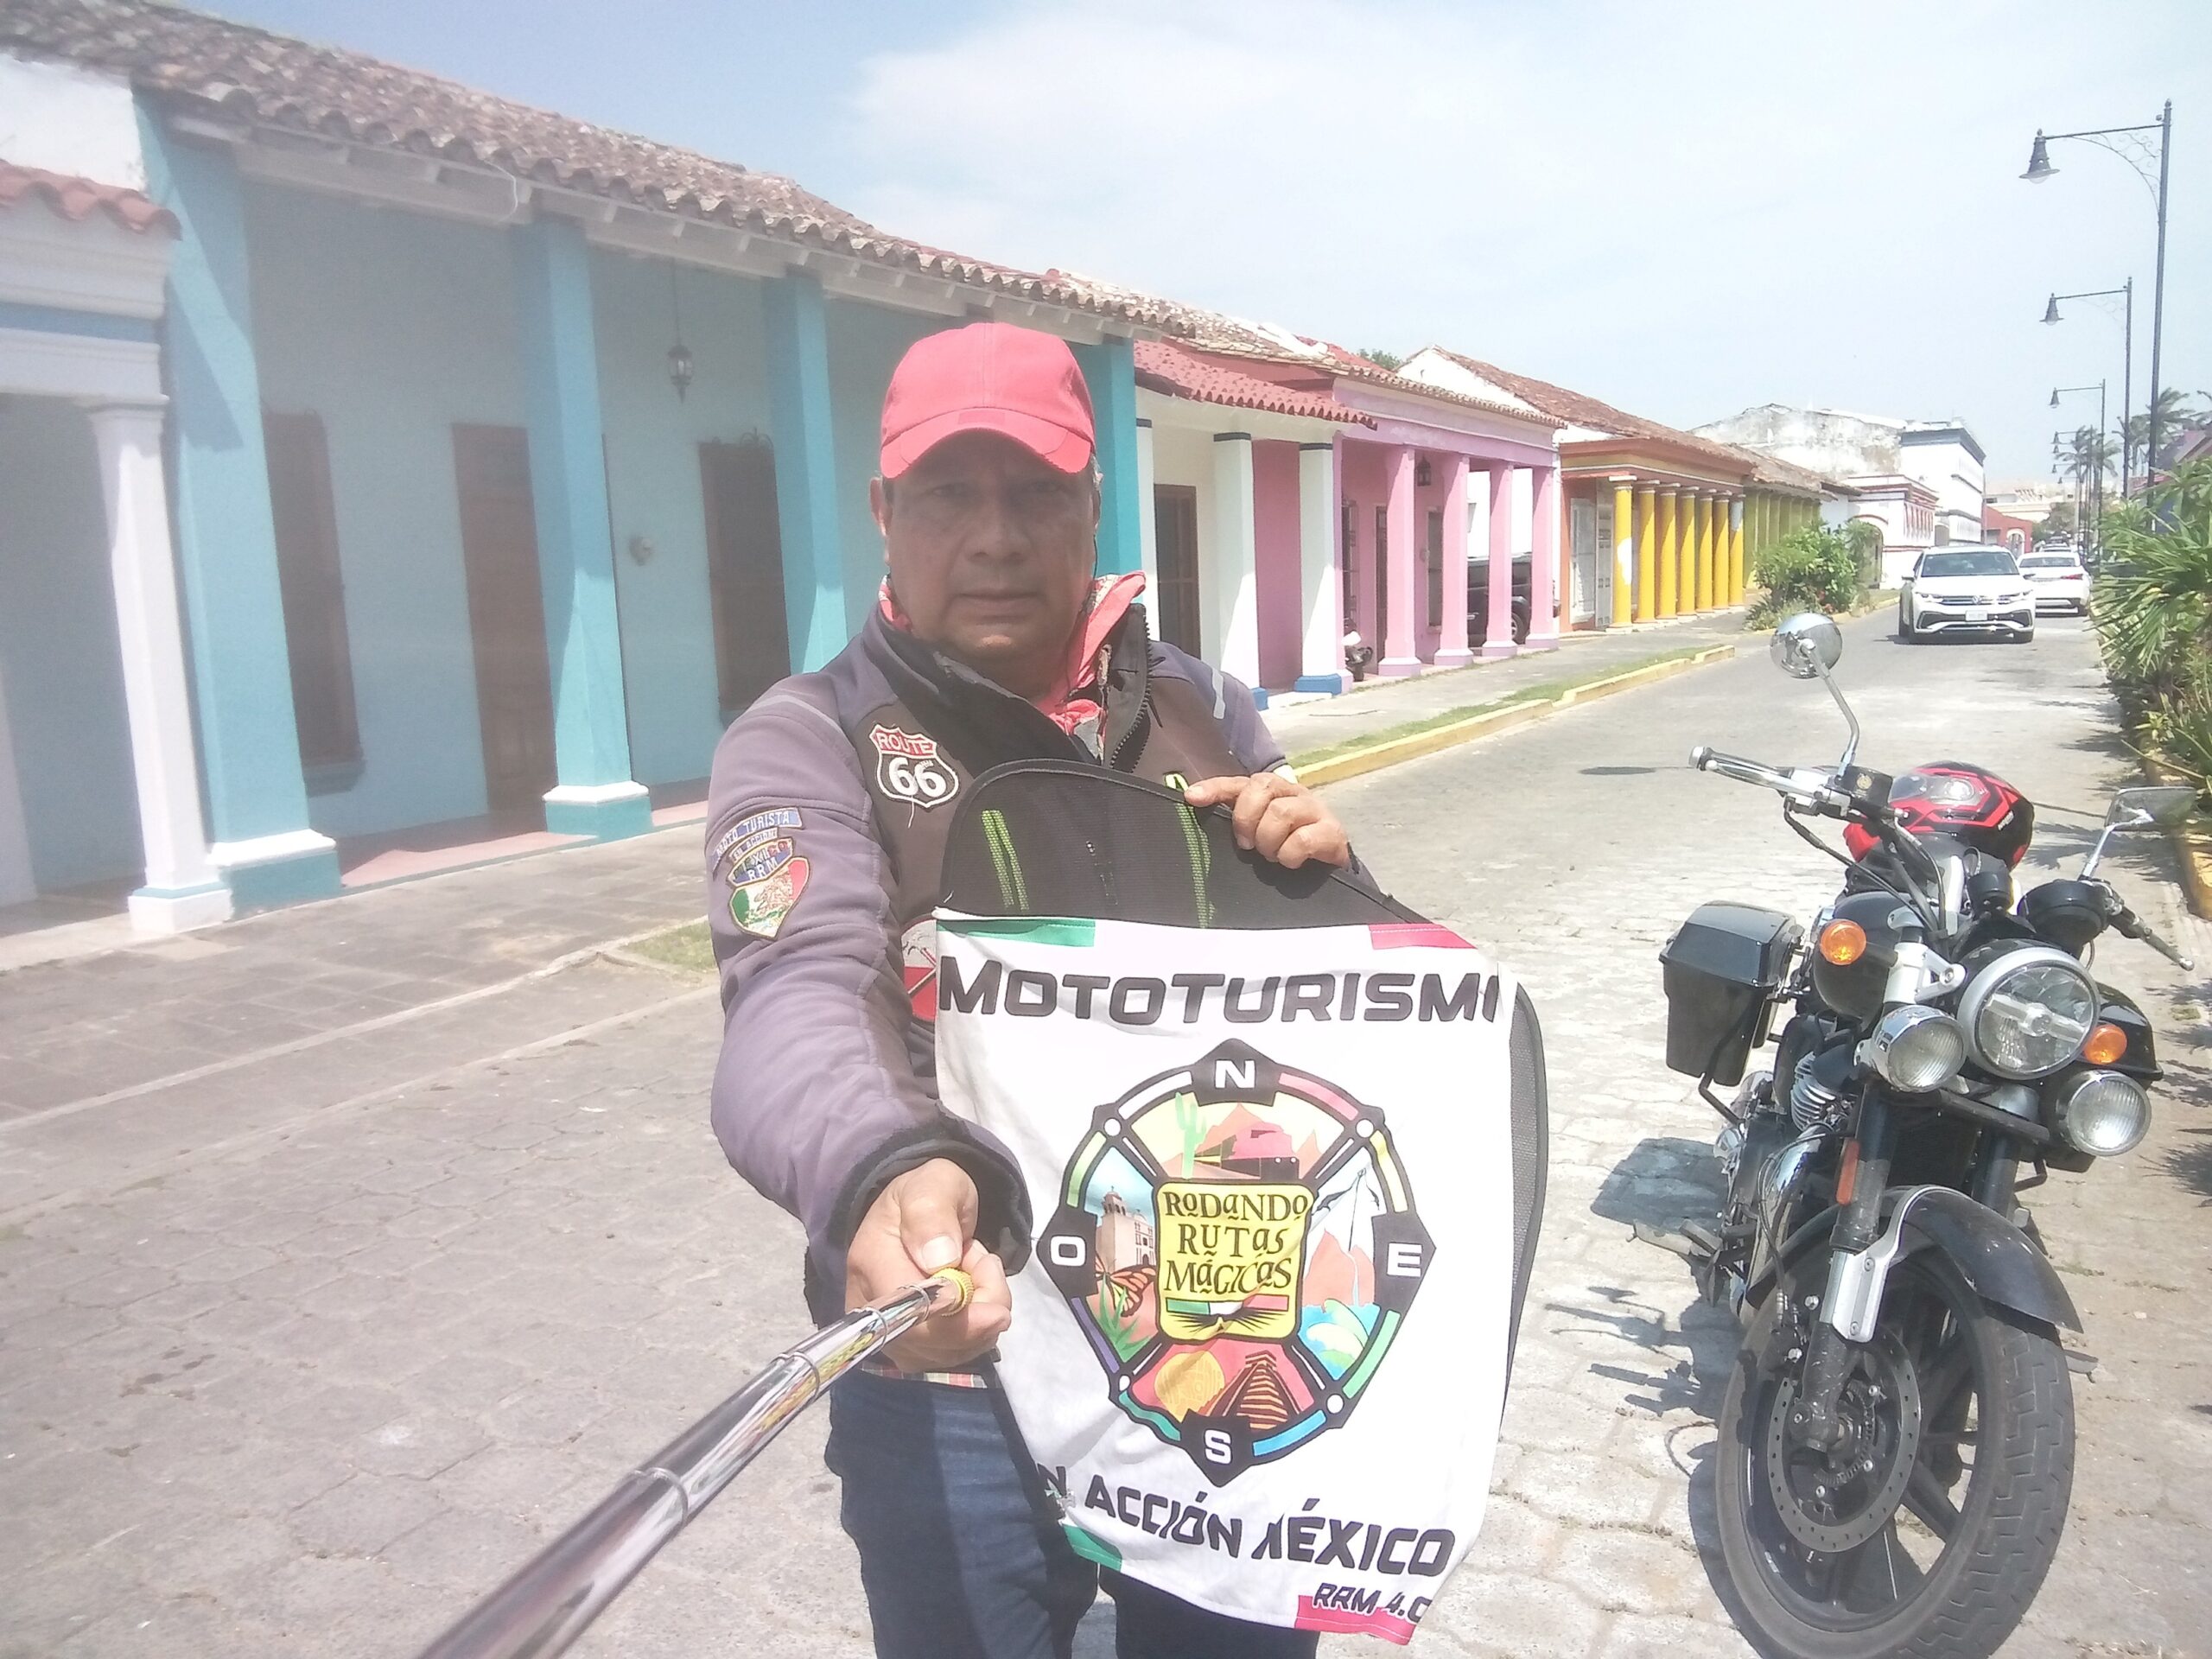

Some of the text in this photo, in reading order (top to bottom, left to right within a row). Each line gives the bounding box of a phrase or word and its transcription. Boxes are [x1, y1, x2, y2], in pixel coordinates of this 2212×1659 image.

[876, 732, 935, 756] ROUTE
[889, 757, 946, 798] 66
[743, 810, 790, 832] TURISTA
[747, 856, 779, 881] RRM
[1214, 1059, 1255, 1089] N
[1051, 1236, 1086, 1267] O
[1387, 1243, 1422, 1277] E
[1205, 1429, 1232, 1465] S
[1037, 1463, 1067, 1497] N
[1084, 1474, 1242, 1558] ACCIÓN
[1313, 1582, 1382, 1614] RRM
